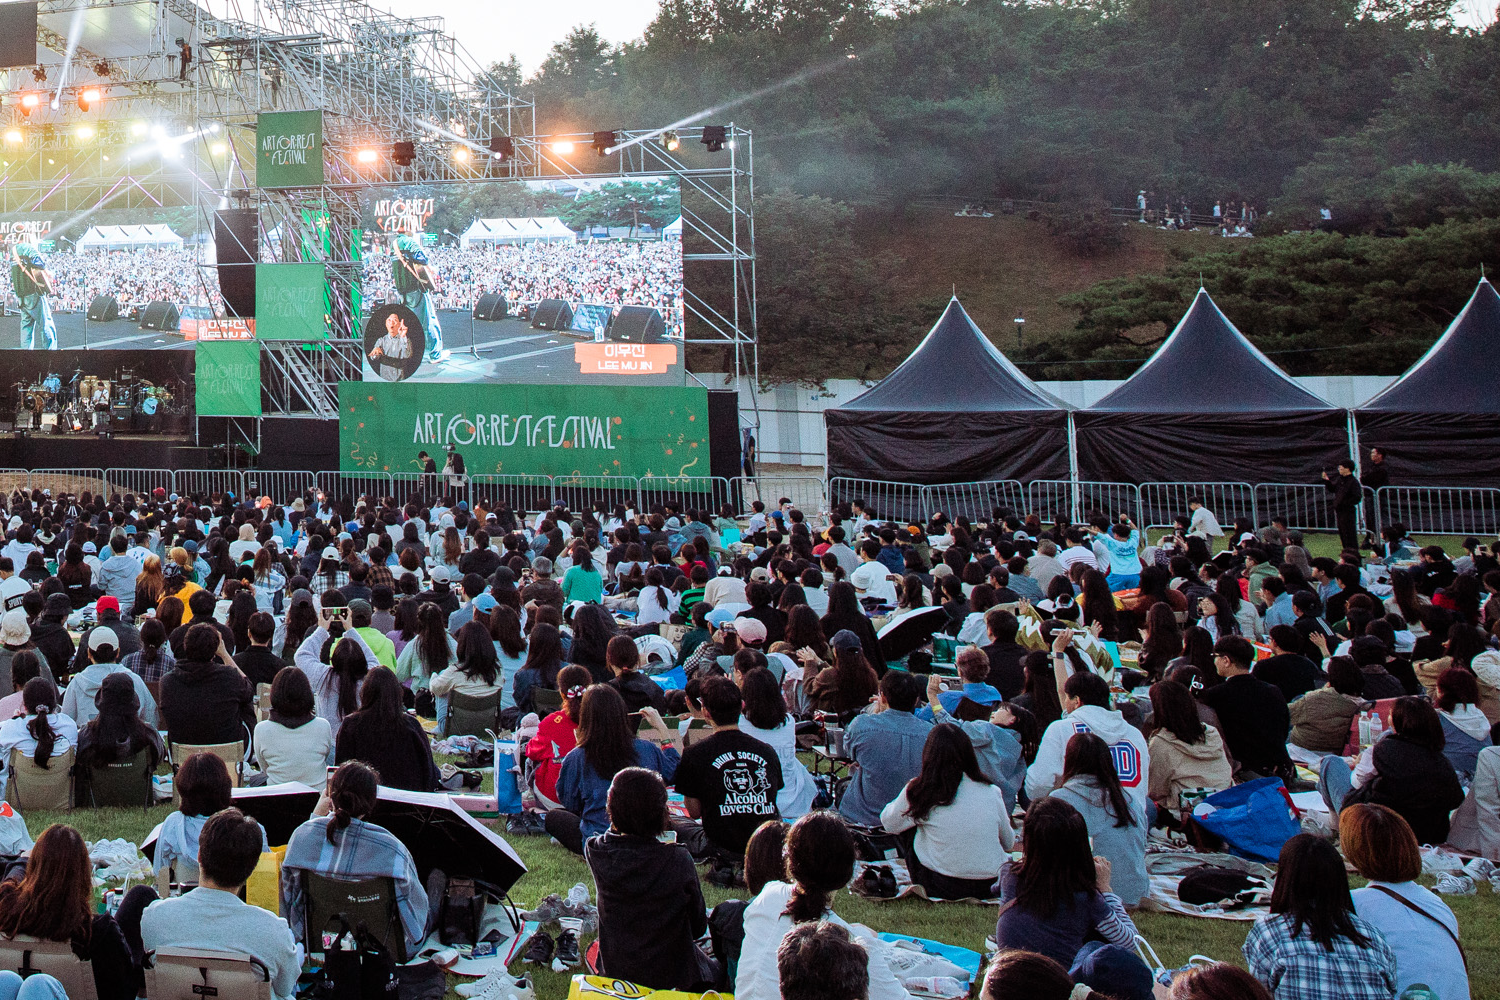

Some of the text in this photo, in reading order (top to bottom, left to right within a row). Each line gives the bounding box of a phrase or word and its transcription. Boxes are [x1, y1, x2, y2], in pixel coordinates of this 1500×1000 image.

[262, 135, 276, 150] ART
[271, 149, 307, 165] FESTIVAL
[374, 199, 390, 216] ART
[604, 344, 645, 358] 이무진
[598, 360, 653, 371] LEE MU JIN
[413, 412, 444, 444] ART
[712, 752, 736, 770] DRINK
[737, 751, 768, 767] SOCIETY
[724, 791, 768, 805] Alcohol
[719, 802, 775, 816] Lovers Club
